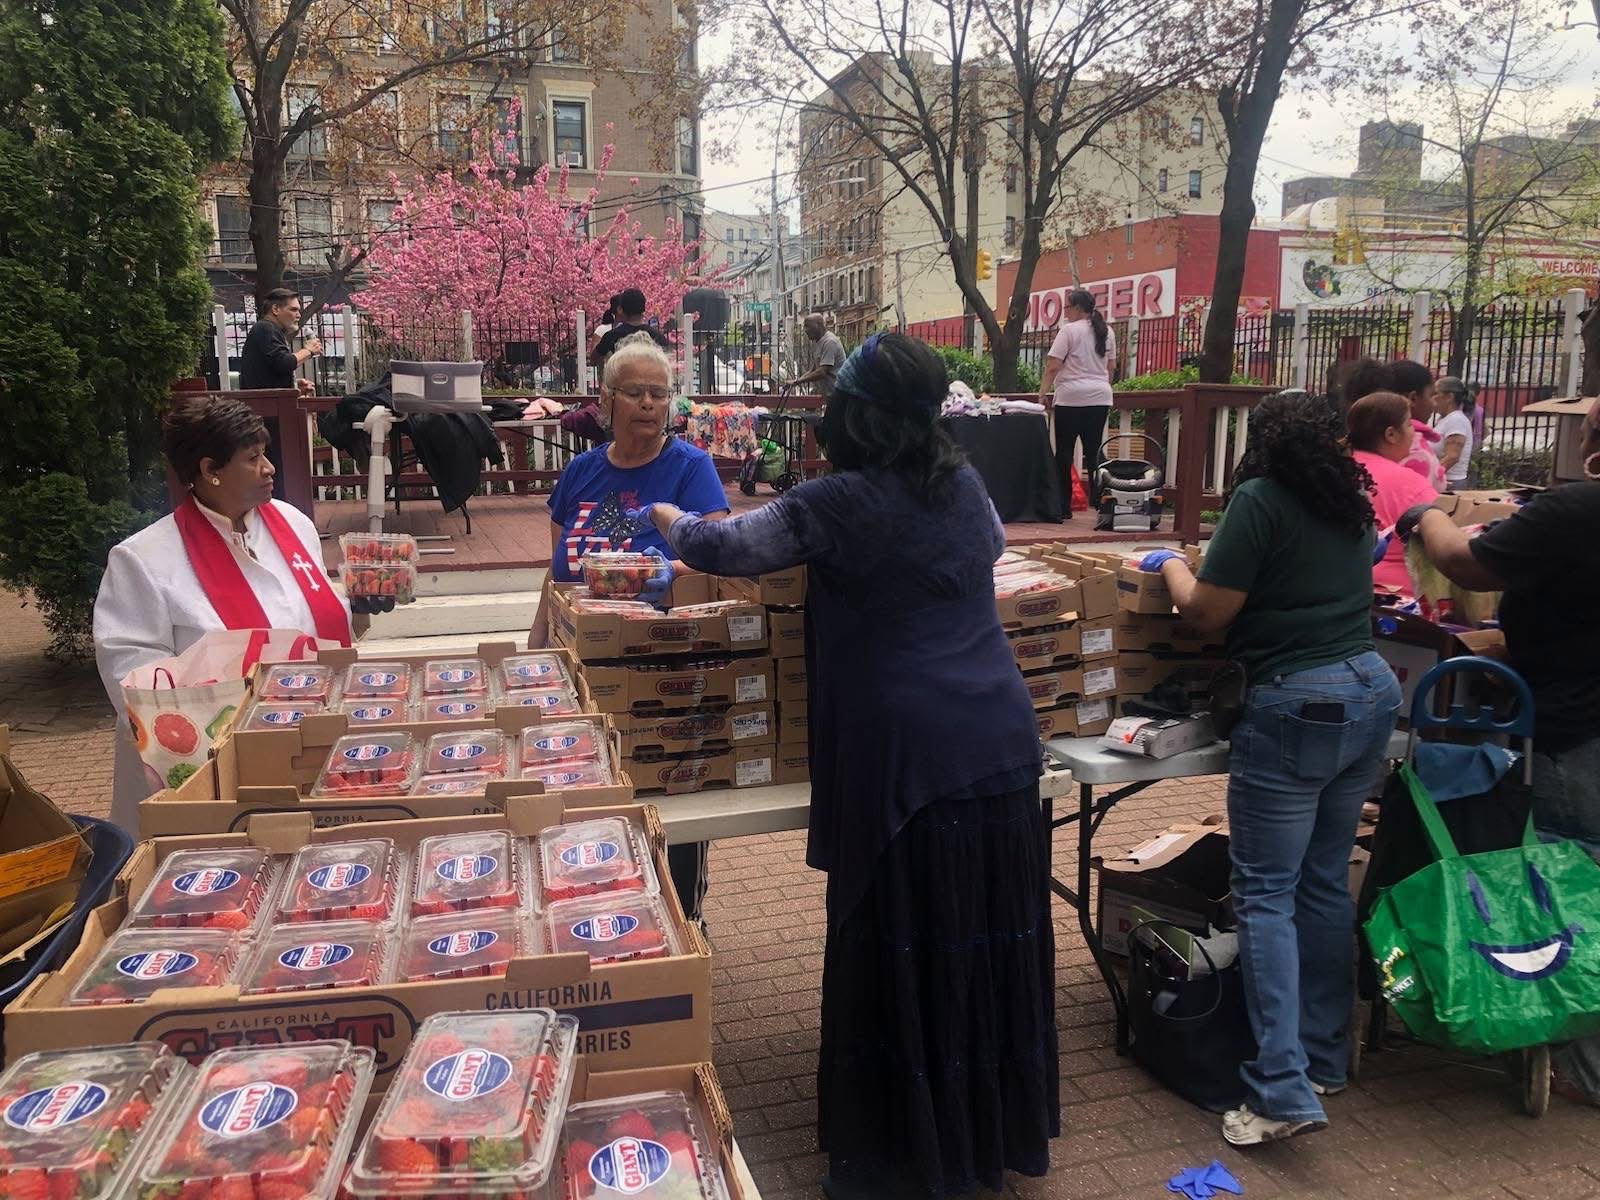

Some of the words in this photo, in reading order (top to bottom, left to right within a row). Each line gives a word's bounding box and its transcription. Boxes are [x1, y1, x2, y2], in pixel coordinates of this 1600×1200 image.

[1542, 260, 1598, 274] WELCOME
[1026, 274, 1163, 329] IOEER
[486, 981, 612, 1011] CALIFORNIA
[216, 1011, 332, 1030] CALIFORNIA
[452, 1054, 483, 1096] GIANT
[34, 1085, 80, 1124] GIANT
[230, 1088, 267, 1132] GIANT
[619, 1142, 643, 1189] GIANT
